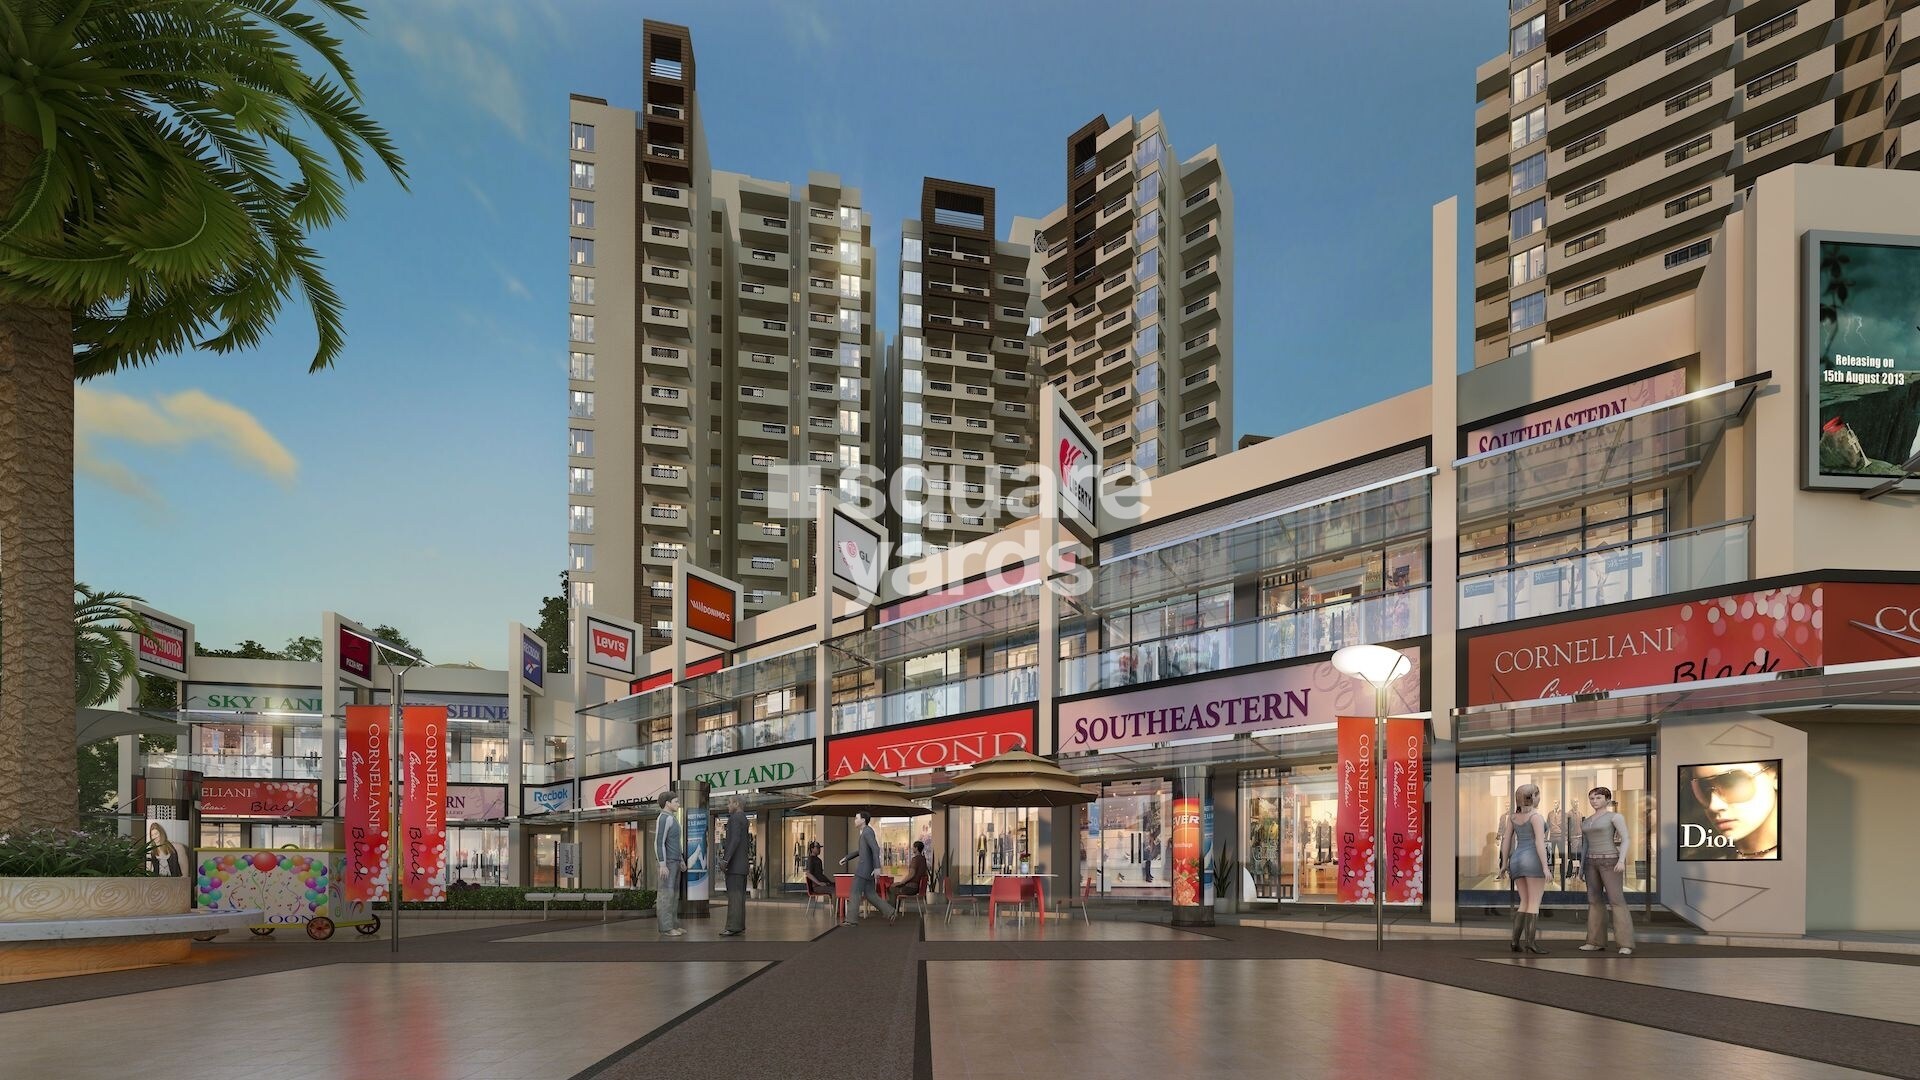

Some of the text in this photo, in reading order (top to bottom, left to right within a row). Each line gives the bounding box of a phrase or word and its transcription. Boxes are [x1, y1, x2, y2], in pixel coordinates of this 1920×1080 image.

[1823, 369, 1905, 386] 15th August 2013
[1835, 354, 1895, 369] Releasing on
[1478, 397, 1627, 453] SOUTHEASTERN
[1494, 626, 1675, 675] CORNELIANI
[1673, 650, 1781, 686] Black
[207, 694, 257, 709] SKY
[447, 703, 509, 720] SHINE
[1074, 688, 1312, 745] SOUTHEASTERN
[368, 723, 381, 828] CORNELIANI
[425, 723, 439, 829] CORNELIANI
[694, 762, 796, 789] SKY LAND
[834, 731, 1027, 777] AMYOND
[201, 786, 252, 798] ELIANI
[1358, 733, 1370, 834] CORNELIANI
[1406, 735, 1418, 834] CORNELIANI
[352, 826, 365, 884] Black
[409, 826, 423, 884] Black
[1343, 831, 1355, 887] Black
[1391, 831, 1404, 886] Black
[1680, 823, 1736, 848] Dior
